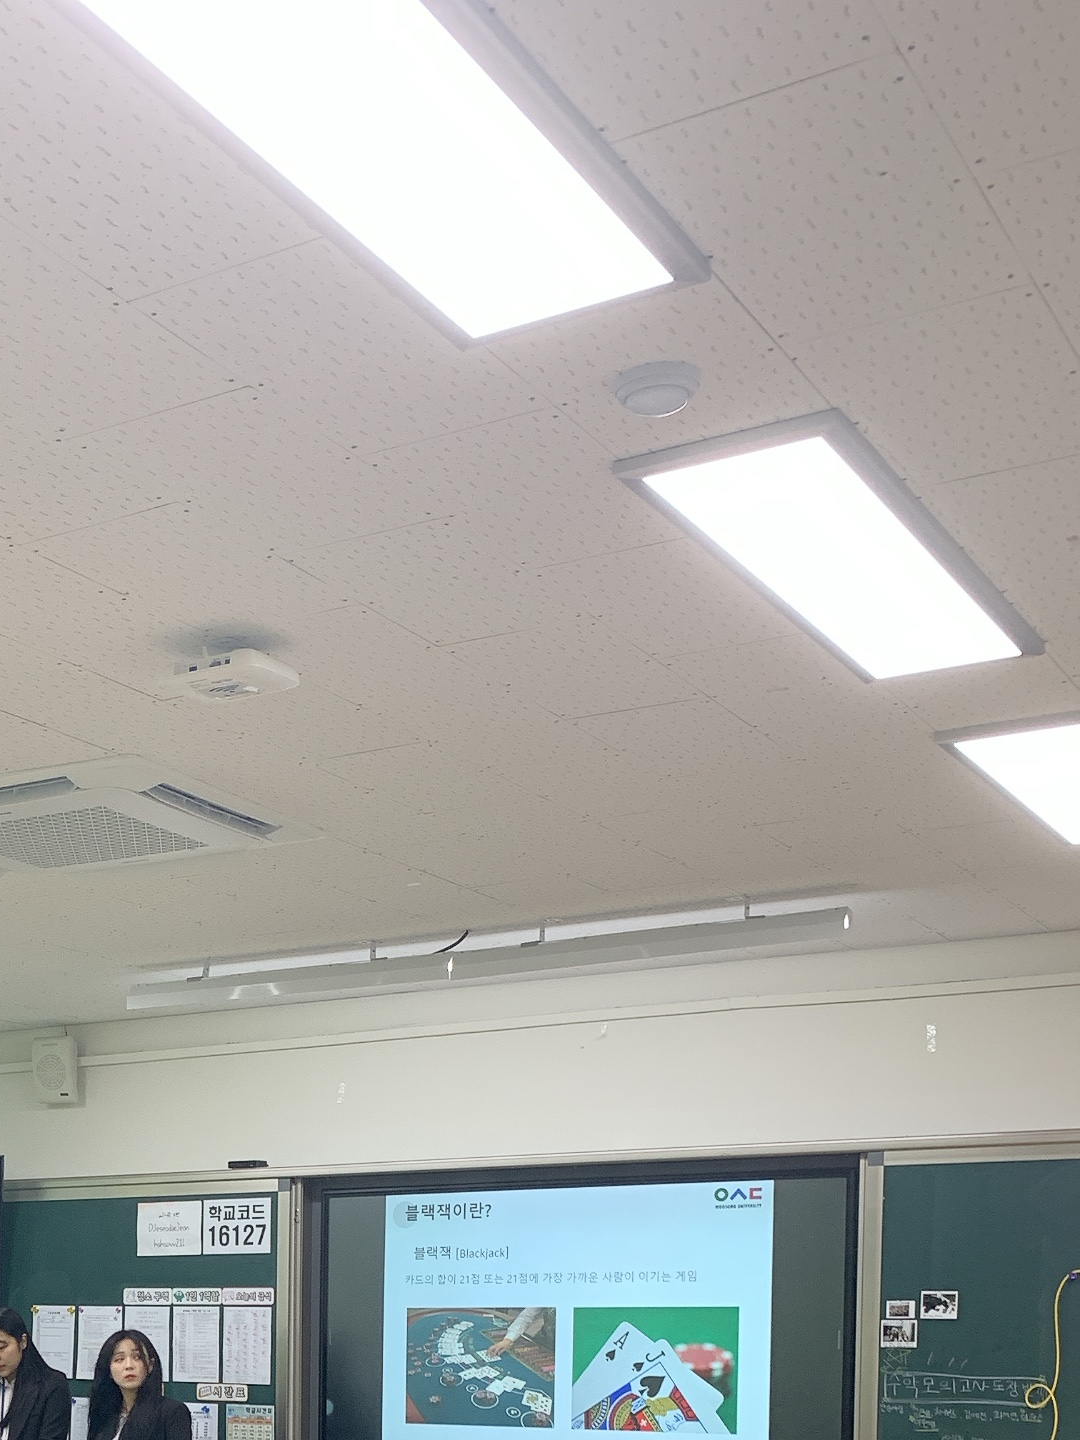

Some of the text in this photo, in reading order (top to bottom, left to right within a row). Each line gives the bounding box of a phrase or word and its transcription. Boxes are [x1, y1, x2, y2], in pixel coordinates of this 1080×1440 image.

[208, 1204, 265, 1222] 학교코드
[405, 1202, 492, 1222] 블랙잭이란?
[208, 1224, 267, 1247] 16127
[413, 1246, 509, 1261] 블랙잭 [Blackjack]
[405, 1270, 697, 1285] 카드의 합이 21점 또는 21점에 가장 가까운 사람이 이기는 게임
[613, 1331, 630, 1350] A
[645, 1350, 666, 1362] J
[213, 1386, 245, 1398] 시간표
[887, 1374, 918, 1399] 수학
[992, 1379, 1019, 1397] 도장
